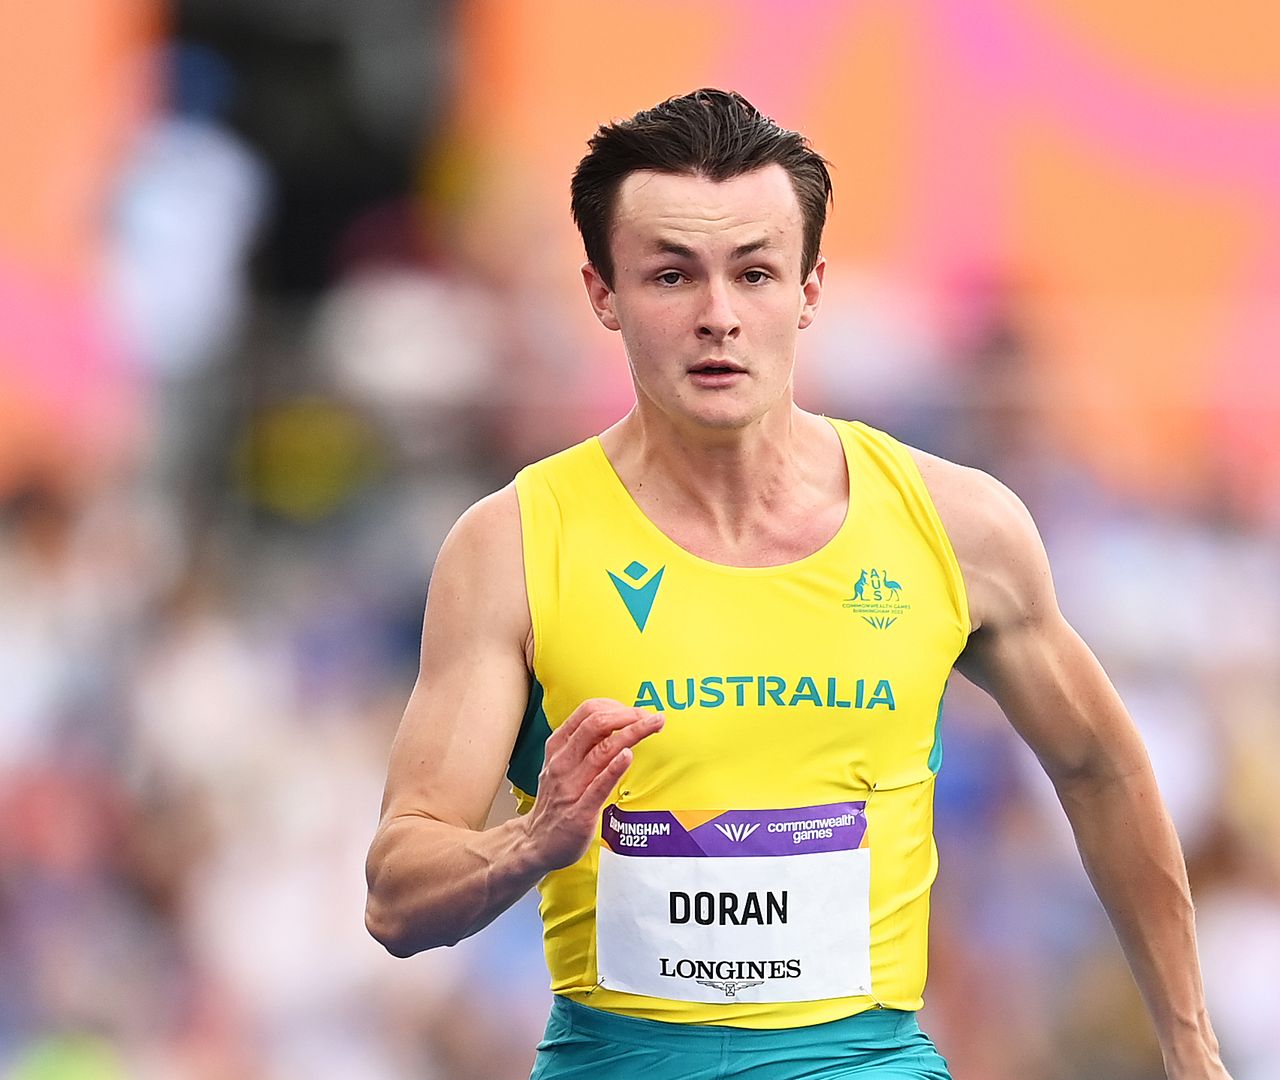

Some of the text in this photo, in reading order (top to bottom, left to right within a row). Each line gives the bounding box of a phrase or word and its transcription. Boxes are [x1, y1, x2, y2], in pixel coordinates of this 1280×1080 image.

[633, 676, 896, 711] AUSTRALIA
[767, 815, 855, 833] commonwealth
[619, 834, 648, 847] 2022
[793, 829, 833, 844] games
[669, 890, 788, 925] DORAN
[659, 958, 802, 979] LONGINES
